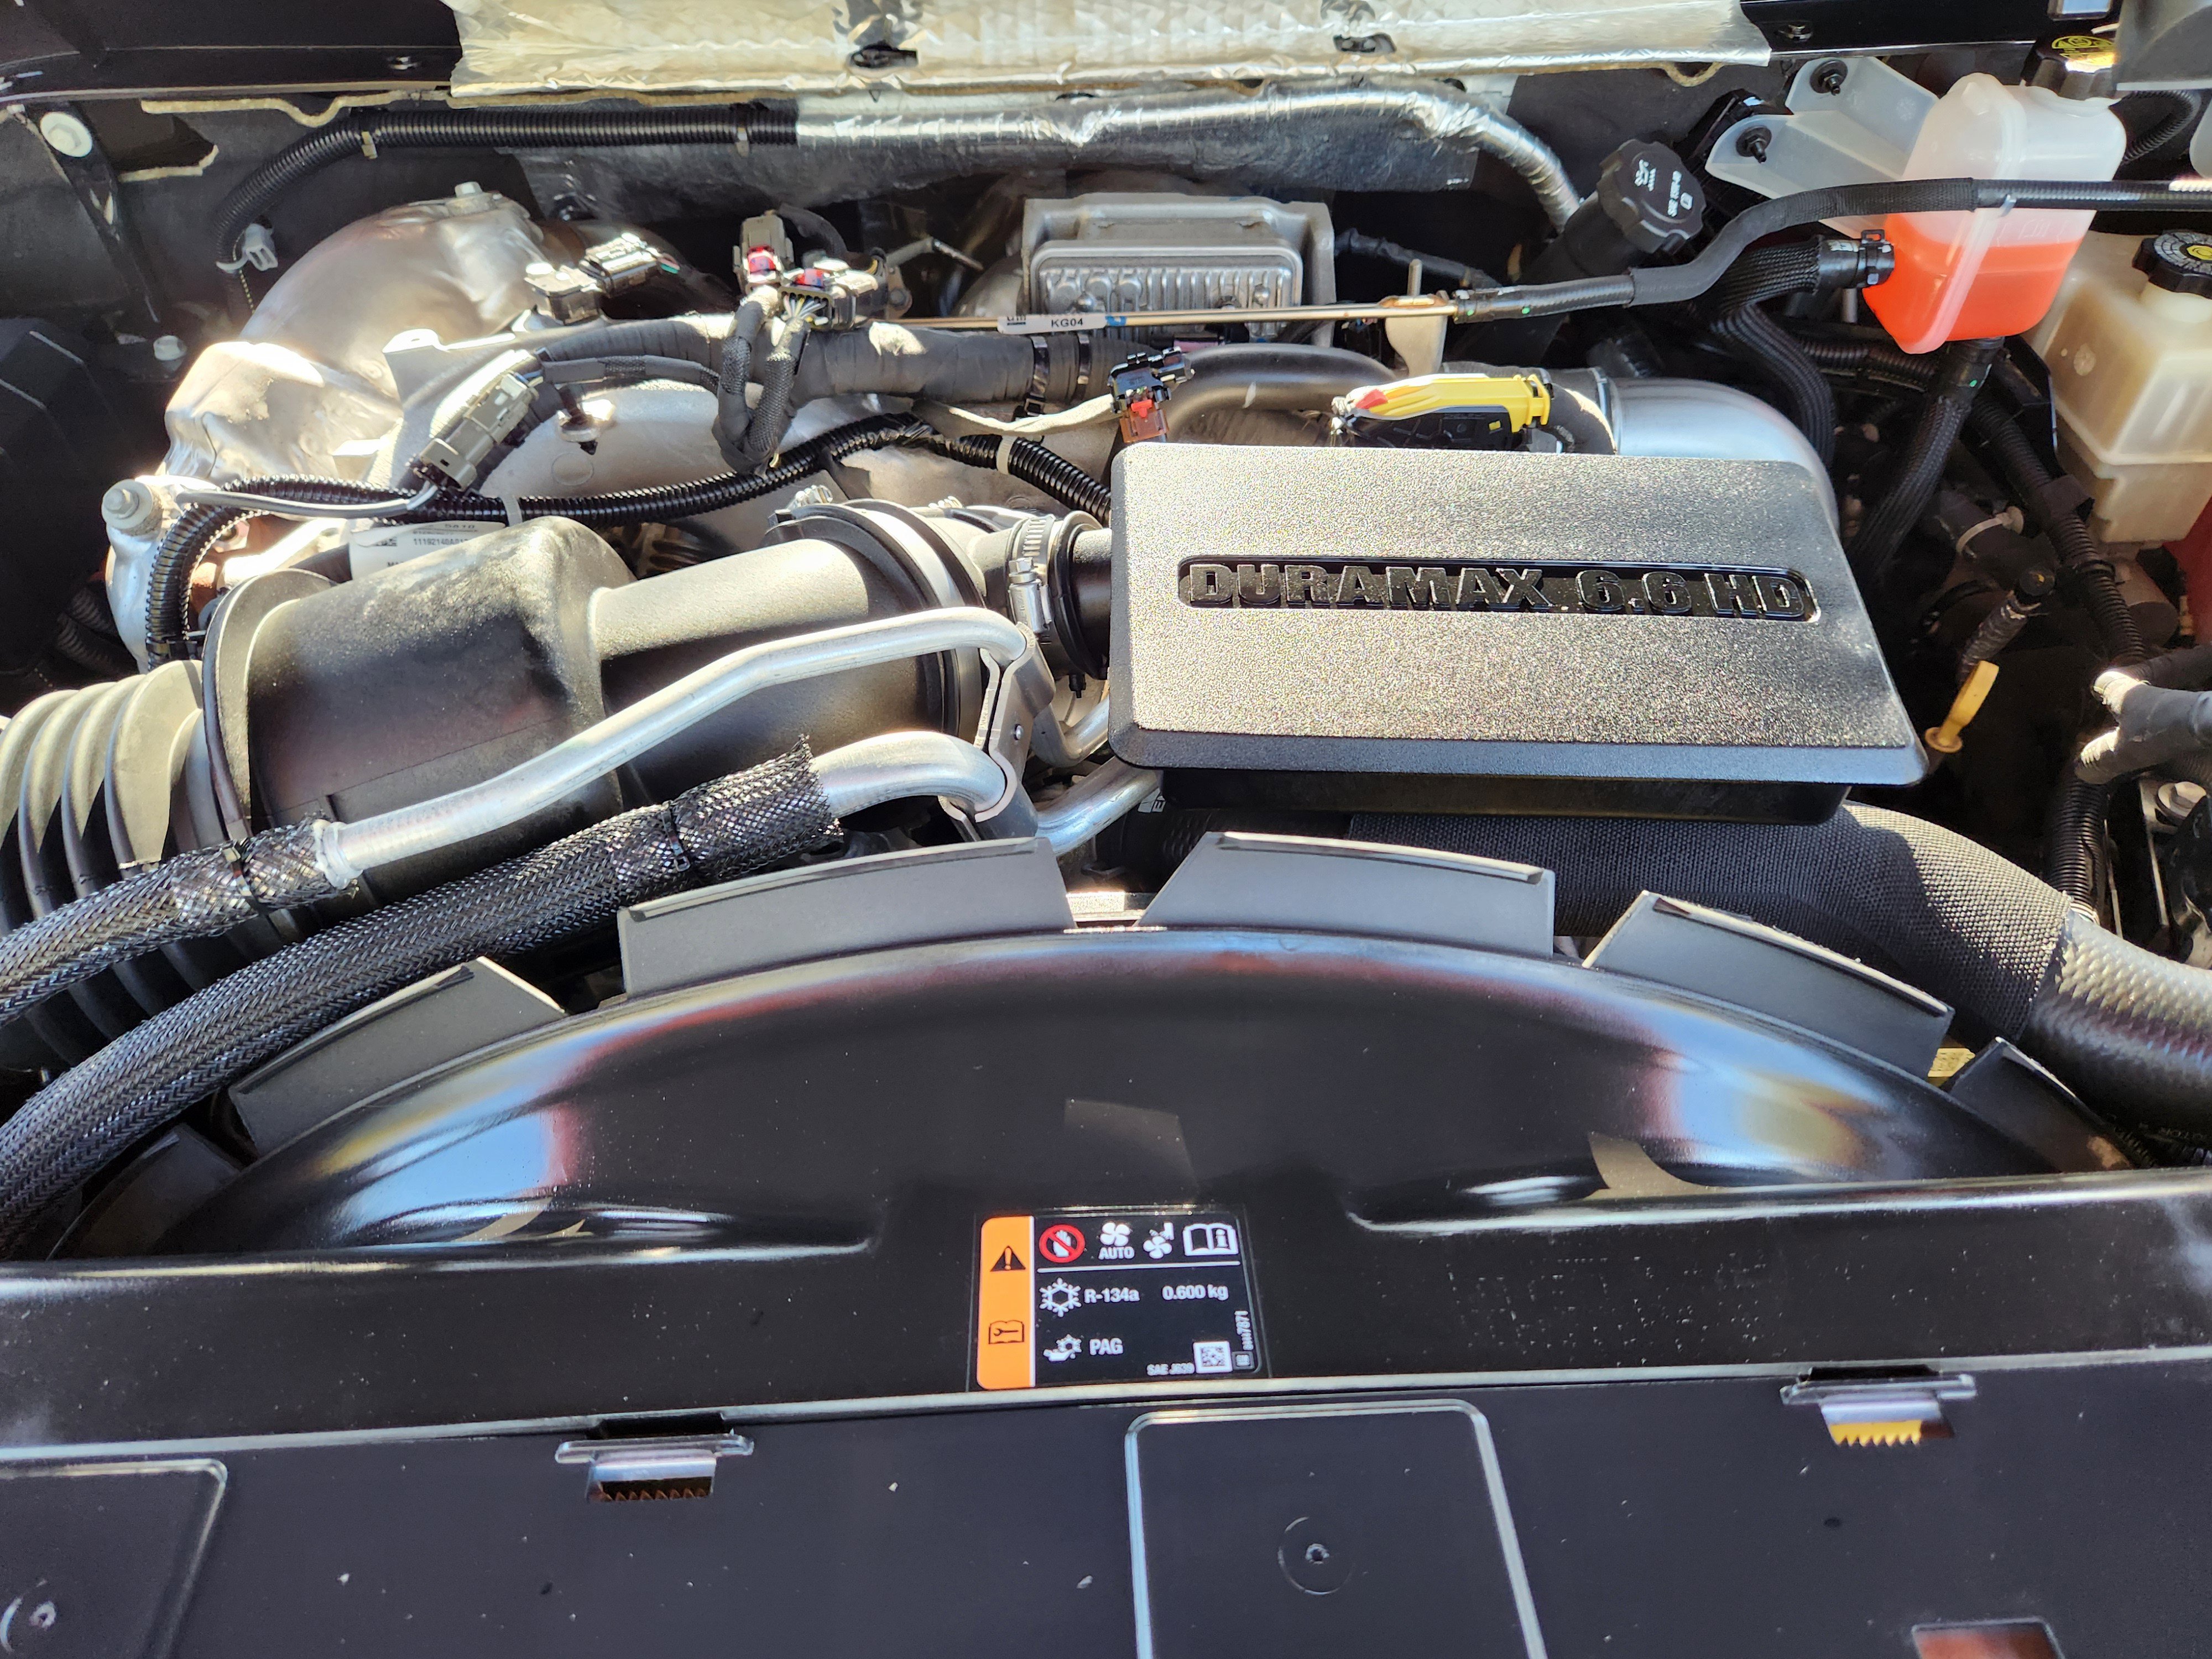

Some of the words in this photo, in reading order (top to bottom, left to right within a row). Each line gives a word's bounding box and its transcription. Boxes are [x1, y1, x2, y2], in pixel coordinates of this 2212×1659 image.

[1051, 318, 1083, 328] KG04
[1189, 564, 1553, 607] DURAMAX
[1575, 570, 1692, 613] 6.6
[1703, 573, 1805, 617] HD
[1098, 1246, 1135, 1260] AUTO
[1084, 1287, 1140, 1303] R-134a
[1162, 1285, 1206, 1300] 0.600
[1207, 1284, 1229, 1301] kg
[1089, 1338, 1123, 1355] PAG
[1147, 1364, 1168, 1376] SAE
